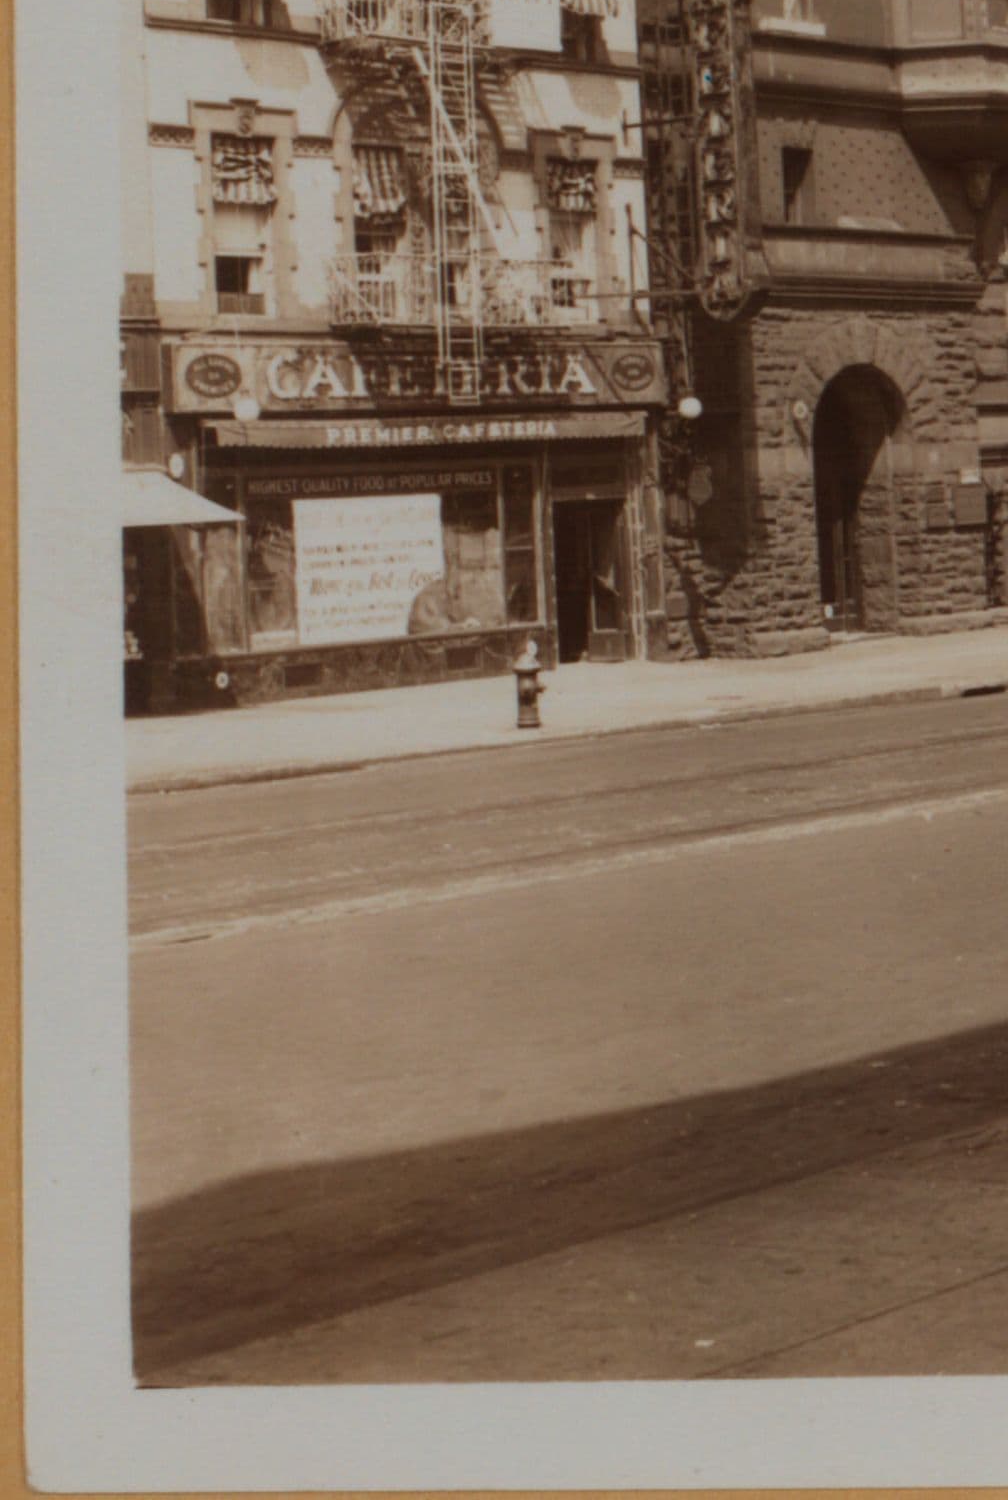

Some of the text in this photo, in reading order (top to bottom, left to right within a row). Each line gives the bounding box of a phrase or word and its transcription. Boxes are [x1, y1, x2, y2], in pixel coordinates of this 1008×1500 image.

[266, 351, 597, 399] CAFETERIA
[326, 420, 557, 445] PREMIER CAFETERIA
[248, 478, 298, 495] HIGHEST
[302, 476, 350, 494] QUALITY
[353, 475, 385, 492] FOOD
[400, 472, 451, 489] POPULAR
[454, 470, 493, 486] PRICES
